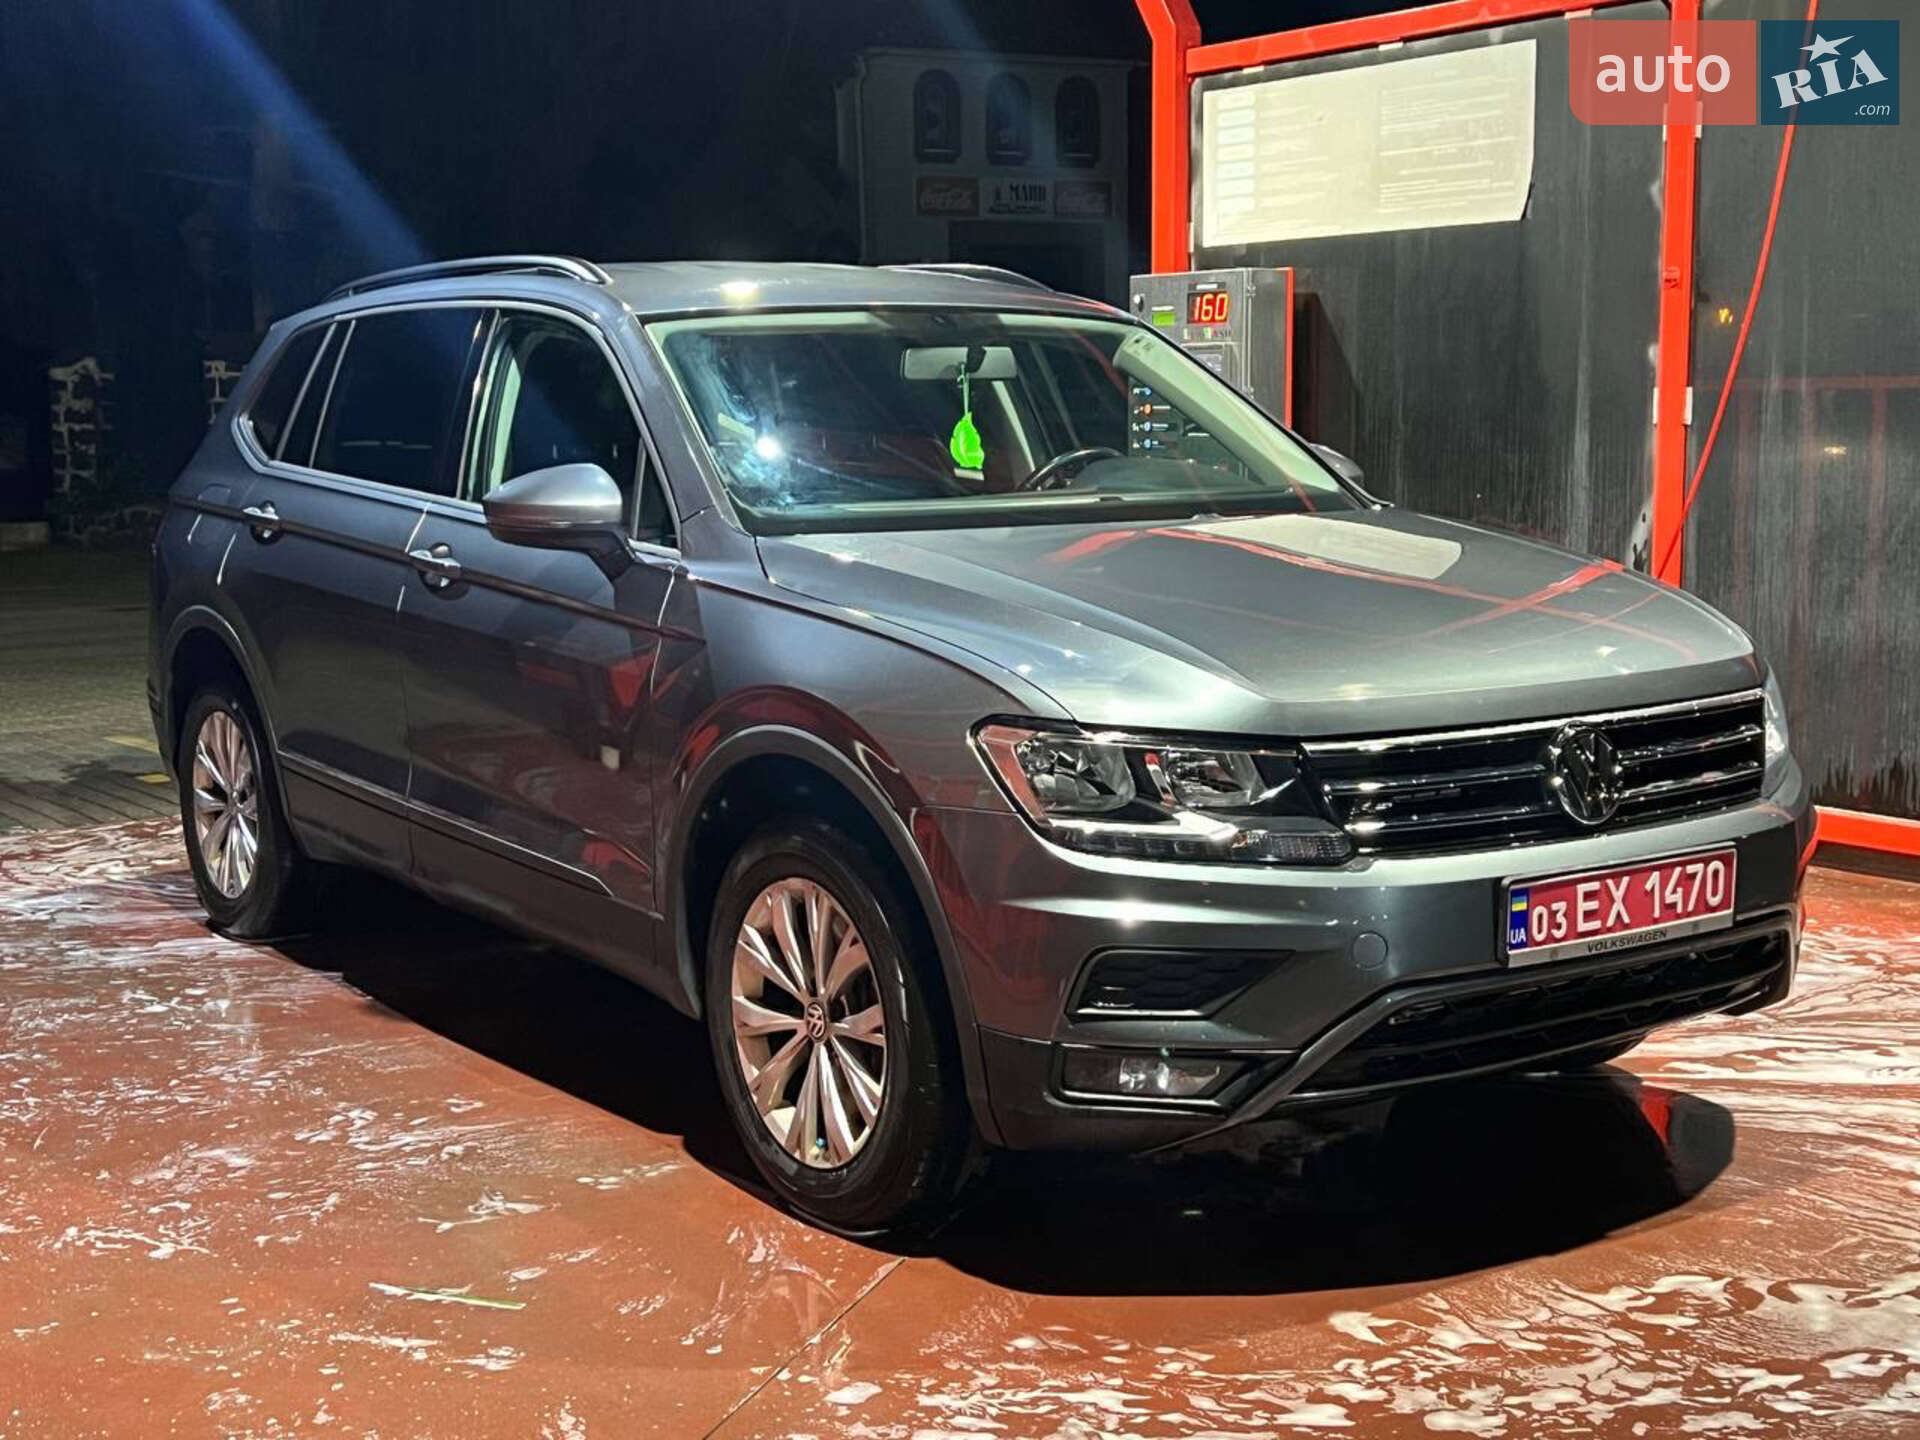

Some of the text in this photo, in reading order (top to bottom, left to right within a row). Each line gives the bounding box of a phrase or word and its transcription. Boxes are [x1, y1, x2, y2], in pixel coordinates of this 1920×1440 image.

[1193, 292, 1230, 322] 160
[1531, 859, 1726, 942] 03 EX 1470
[1510, 927, 1527, 944] UA
[1586, 928, 1668, 954] VOLKSWAGEN
